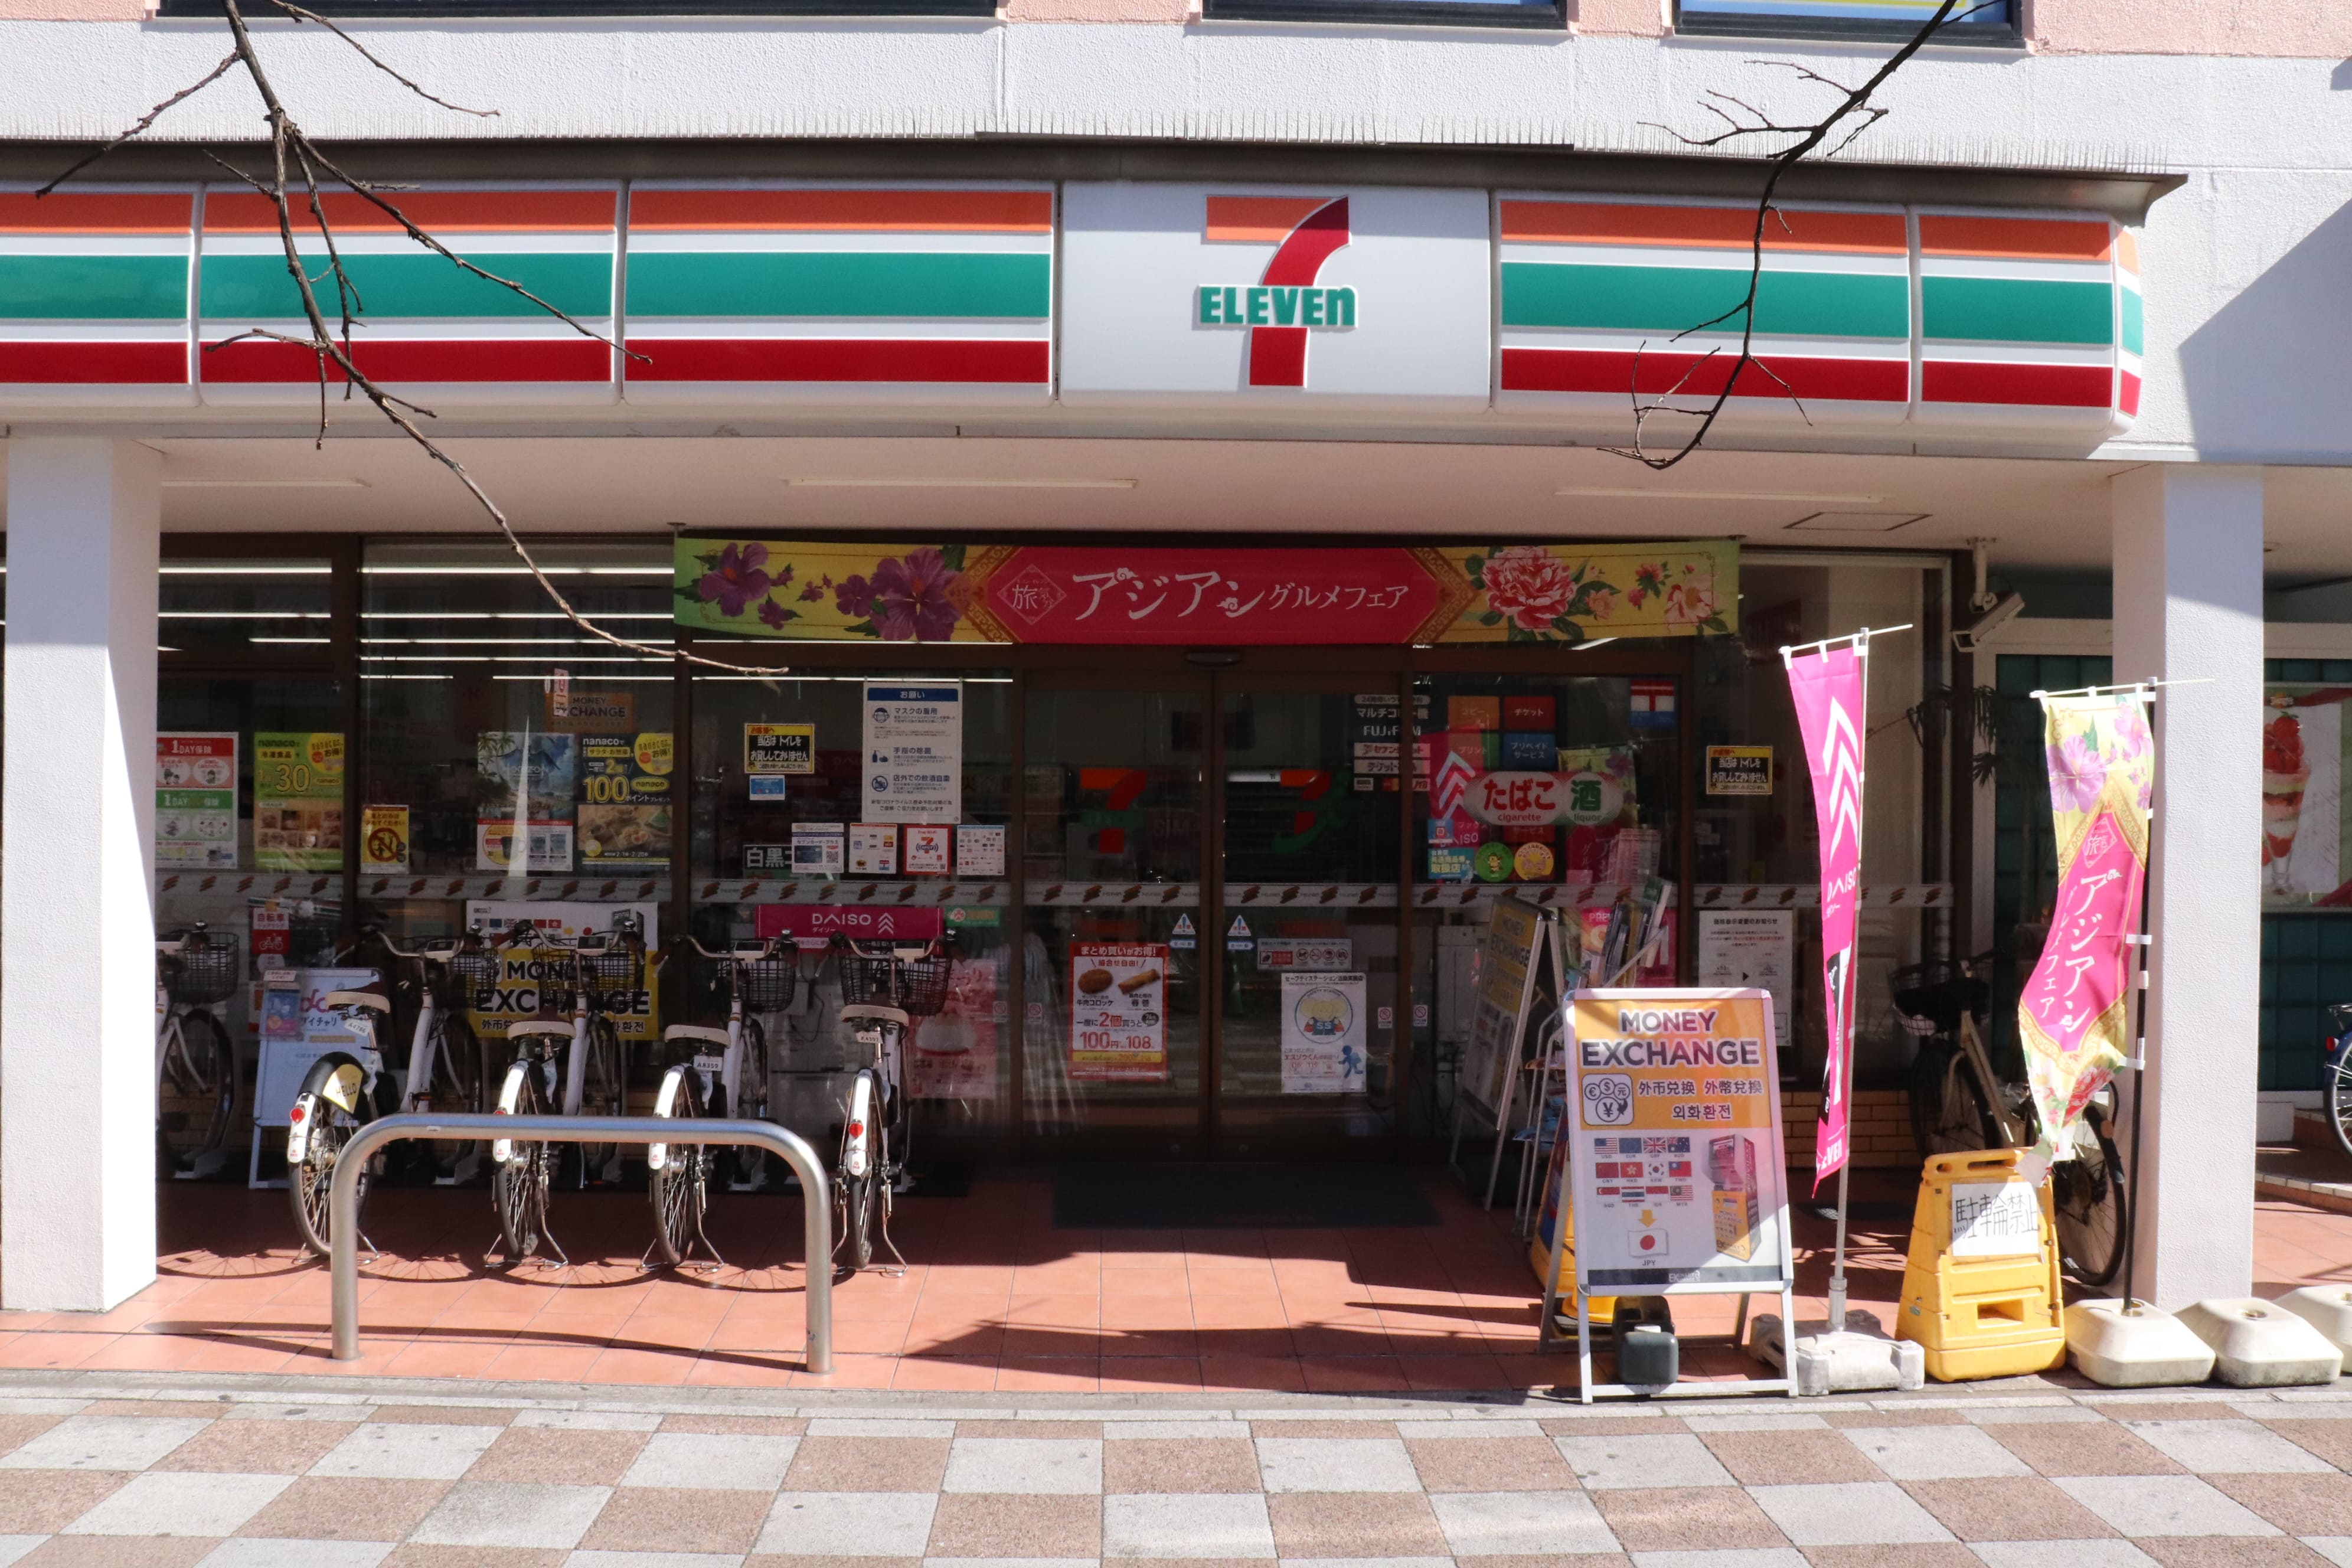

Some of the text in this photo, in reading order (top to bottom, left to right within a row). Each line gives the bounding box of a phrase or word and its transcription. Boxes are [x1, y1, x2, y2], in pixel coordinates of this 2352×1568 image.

[1207, 195, 1349, 386] 7
[1072, 567, 1265, 620] アジアン
[1268, 583, 1409, 609] グルメフェア
[1514, 708, 1544, 717] チケット
[275, 763, 311, 792] 30
[1484, 779, 1602, 812] たばこ 酒
[1497, 814, 1602, 822] cigarette liquor
[812, 913, 872, 926] DAISO
[1081, 946, 1157, 956] まとめ買いがお得!
[2059, 869, 2123, 1033] アジアン
[1621, 1011, 1717, 1033] MONEY
[1582, 1040, 1759, 1066] EXCHANGE
[336, 1083, 357, 1097] HELLO
[1638, 1080, 1696, 1096] 外币兑换
[1672, 1103, 1732, 1120] 외화환전
[1954, 1191, 2040, 1239] 駐輪禁止
